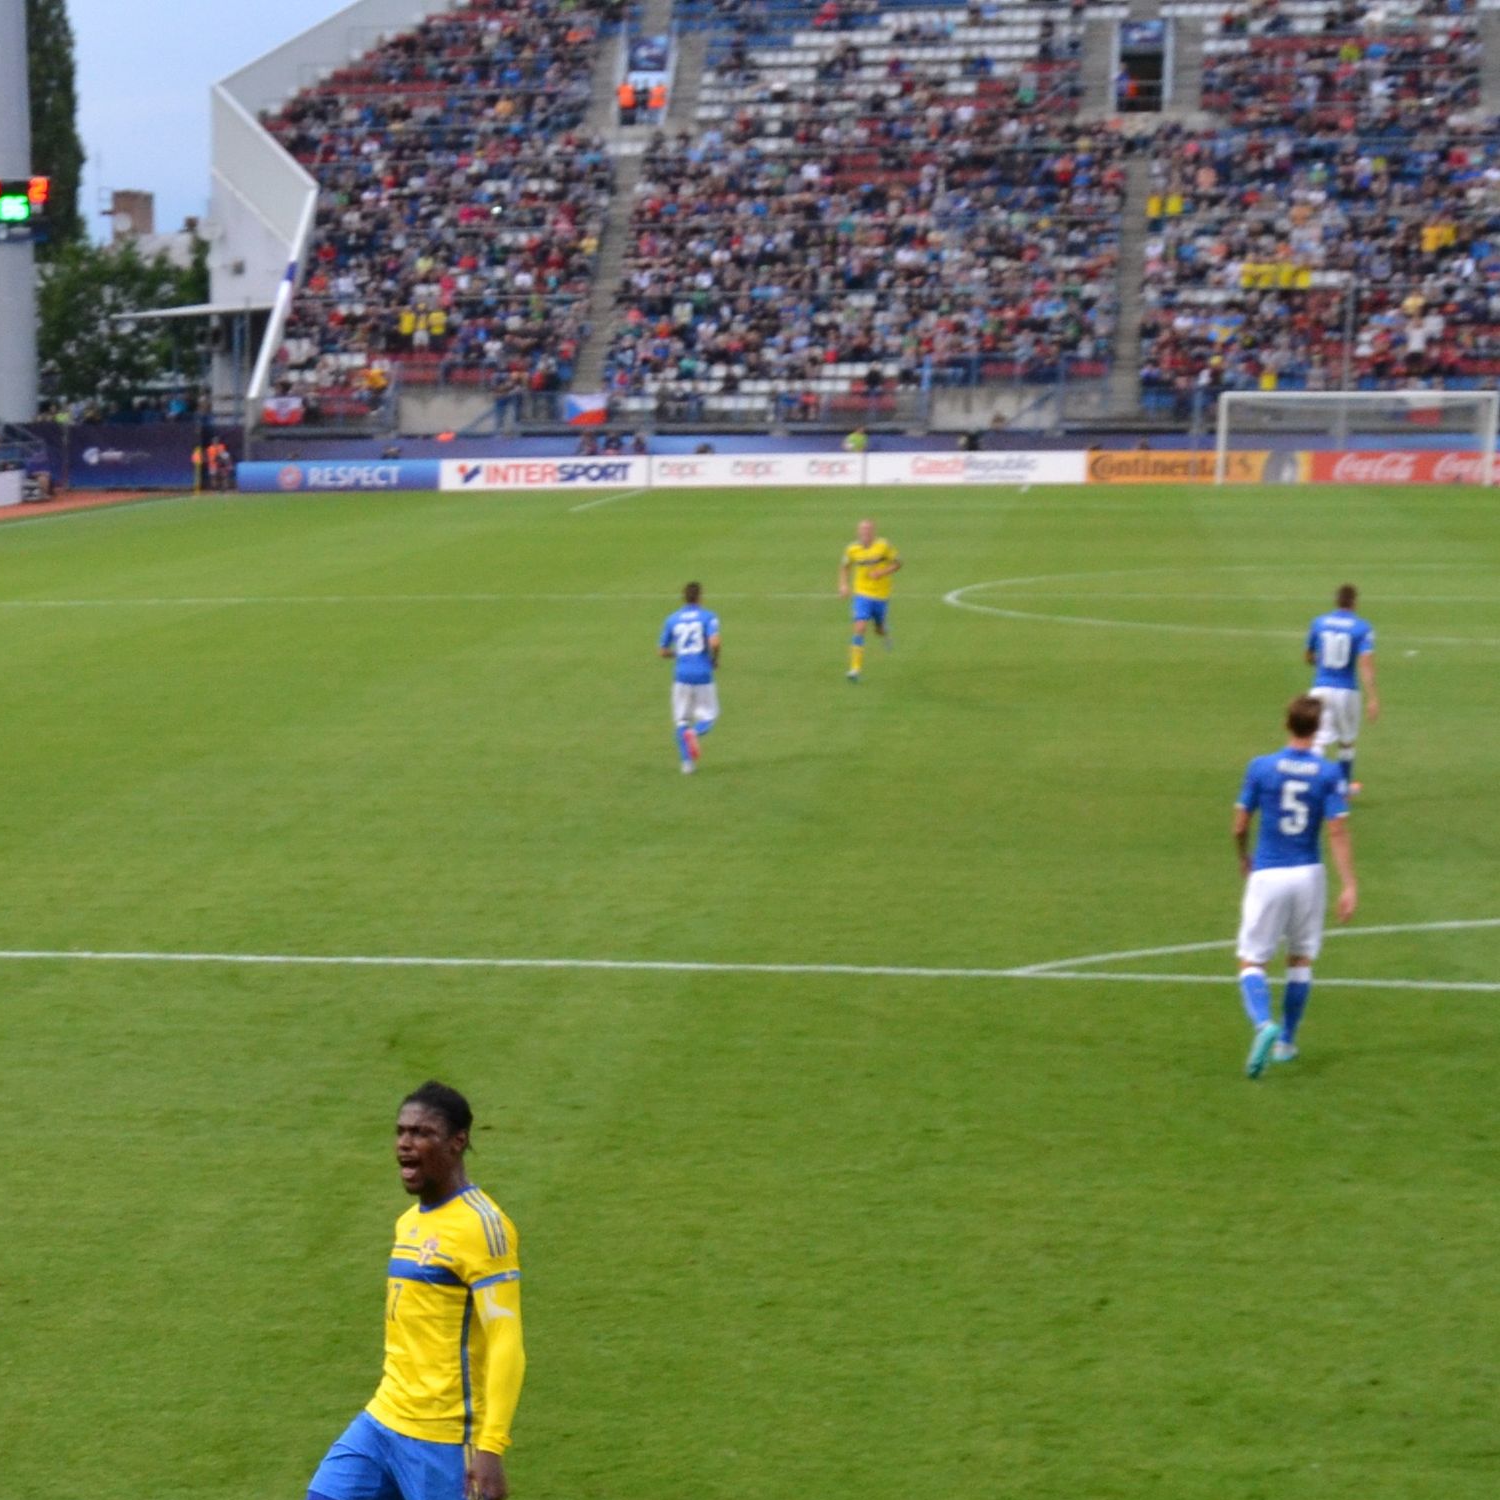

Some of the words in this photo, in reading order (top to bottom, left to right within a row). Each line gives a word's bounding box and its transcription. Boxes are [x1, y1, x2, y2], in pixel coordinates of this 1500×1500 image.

[28, 176, 48, 204] 2
[307, 466, 400, 487] RESPECT
[485, 463, 631, 483] INTERSPORT
[1332, 452, 1419, 481] Coca-Cola
[673, 622, 704, 654] 23
[1321, 630, 1351, 669] 10
[1281, 780, 1309, 835] 5
